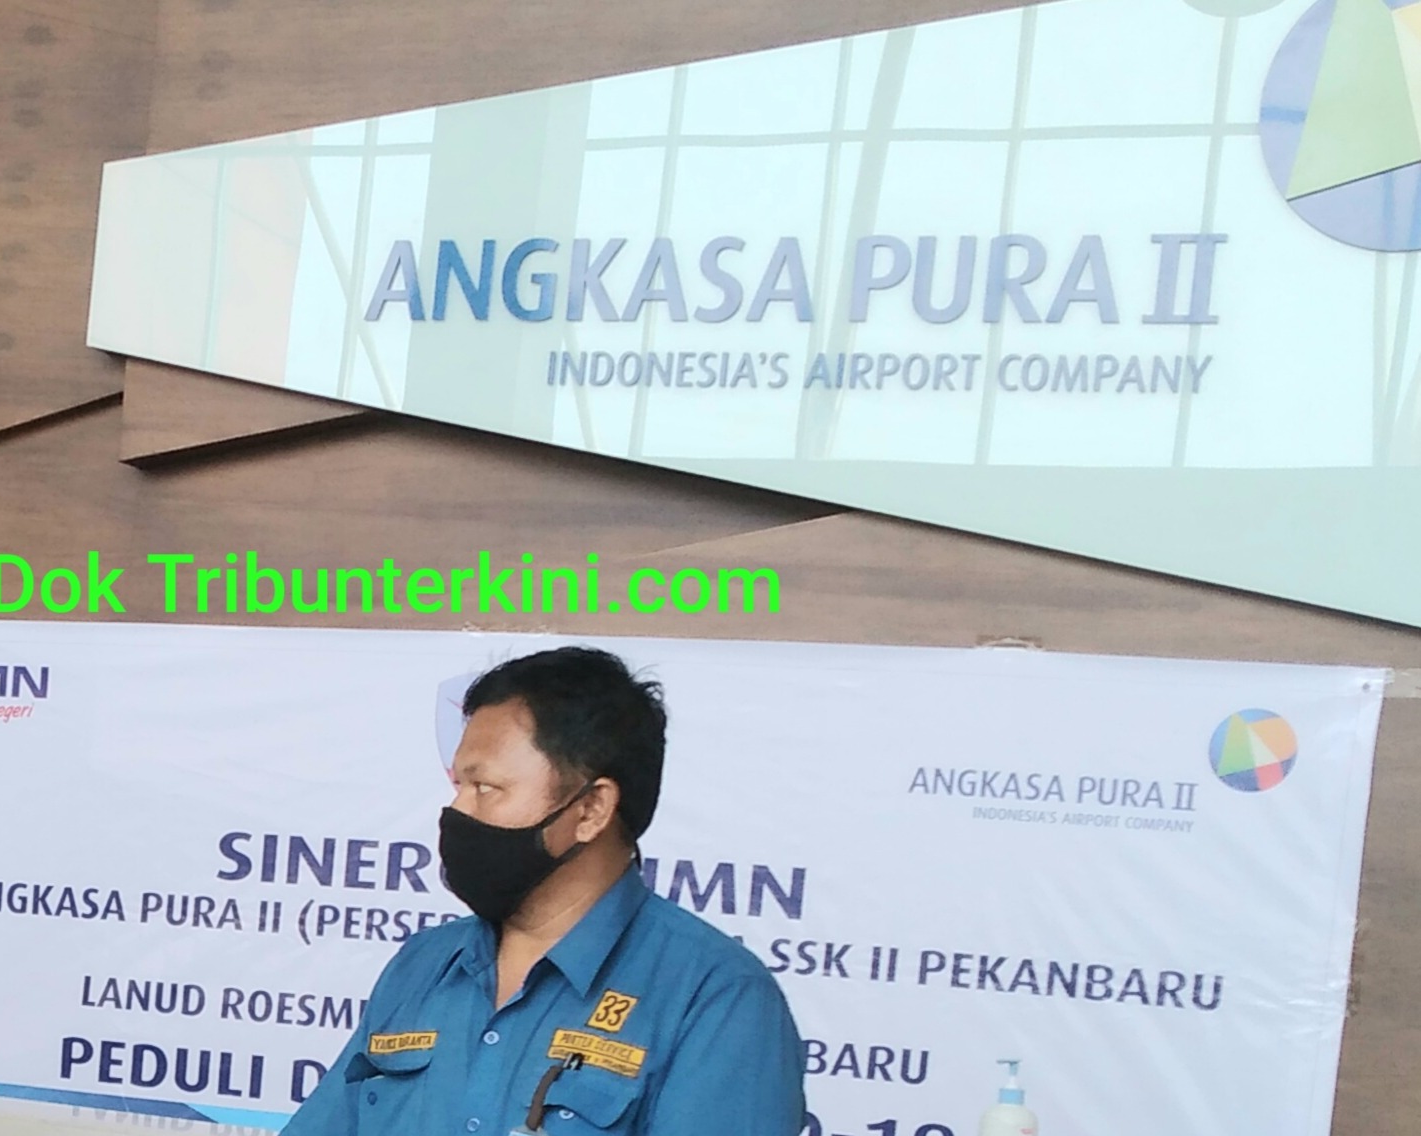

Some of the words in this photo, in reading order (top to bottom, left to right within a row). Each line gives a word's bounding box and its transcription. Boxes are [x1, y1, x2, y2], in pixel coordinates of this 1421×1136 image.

[364, 236, 814, 323] ANGKASA
[849, 234, 1120, 324] PURA
[1142, 233, 1229, 325] II
[547, 351, 789, 389] INDONESIA'S
[804, 352, 981, 391] AIRPORT
[998, 354, 1213, 394] COMPANY
[908, 767, 1065, 803] ANGKASA
[1077, 776, 1164, 809] PURA
[1171, 782, 1199, 811] II
[973, 806, 1057, 824] INDONESIA'S
[1062, 812, 1119, 829] AIRPORT
[1125, 816, 1194, 833] COMPANY
[216, 832, 447, 893] SINER
[643, 857, 807, 920] MN
[140, 892, 243, 931] PURA
[258, 900, 282, 933] II
[767, 938, 853, 978] SSK
[870, 946, 899, 982] II
[917, 950, 1224, 1011] PEKANBARU
[81, 975, 205, 1017] LANUD
[802, 1039, 929, 1084] BARU
[595, 994, 630, 1026] 33
[59, 1036, 264, 1099] PEDULI
